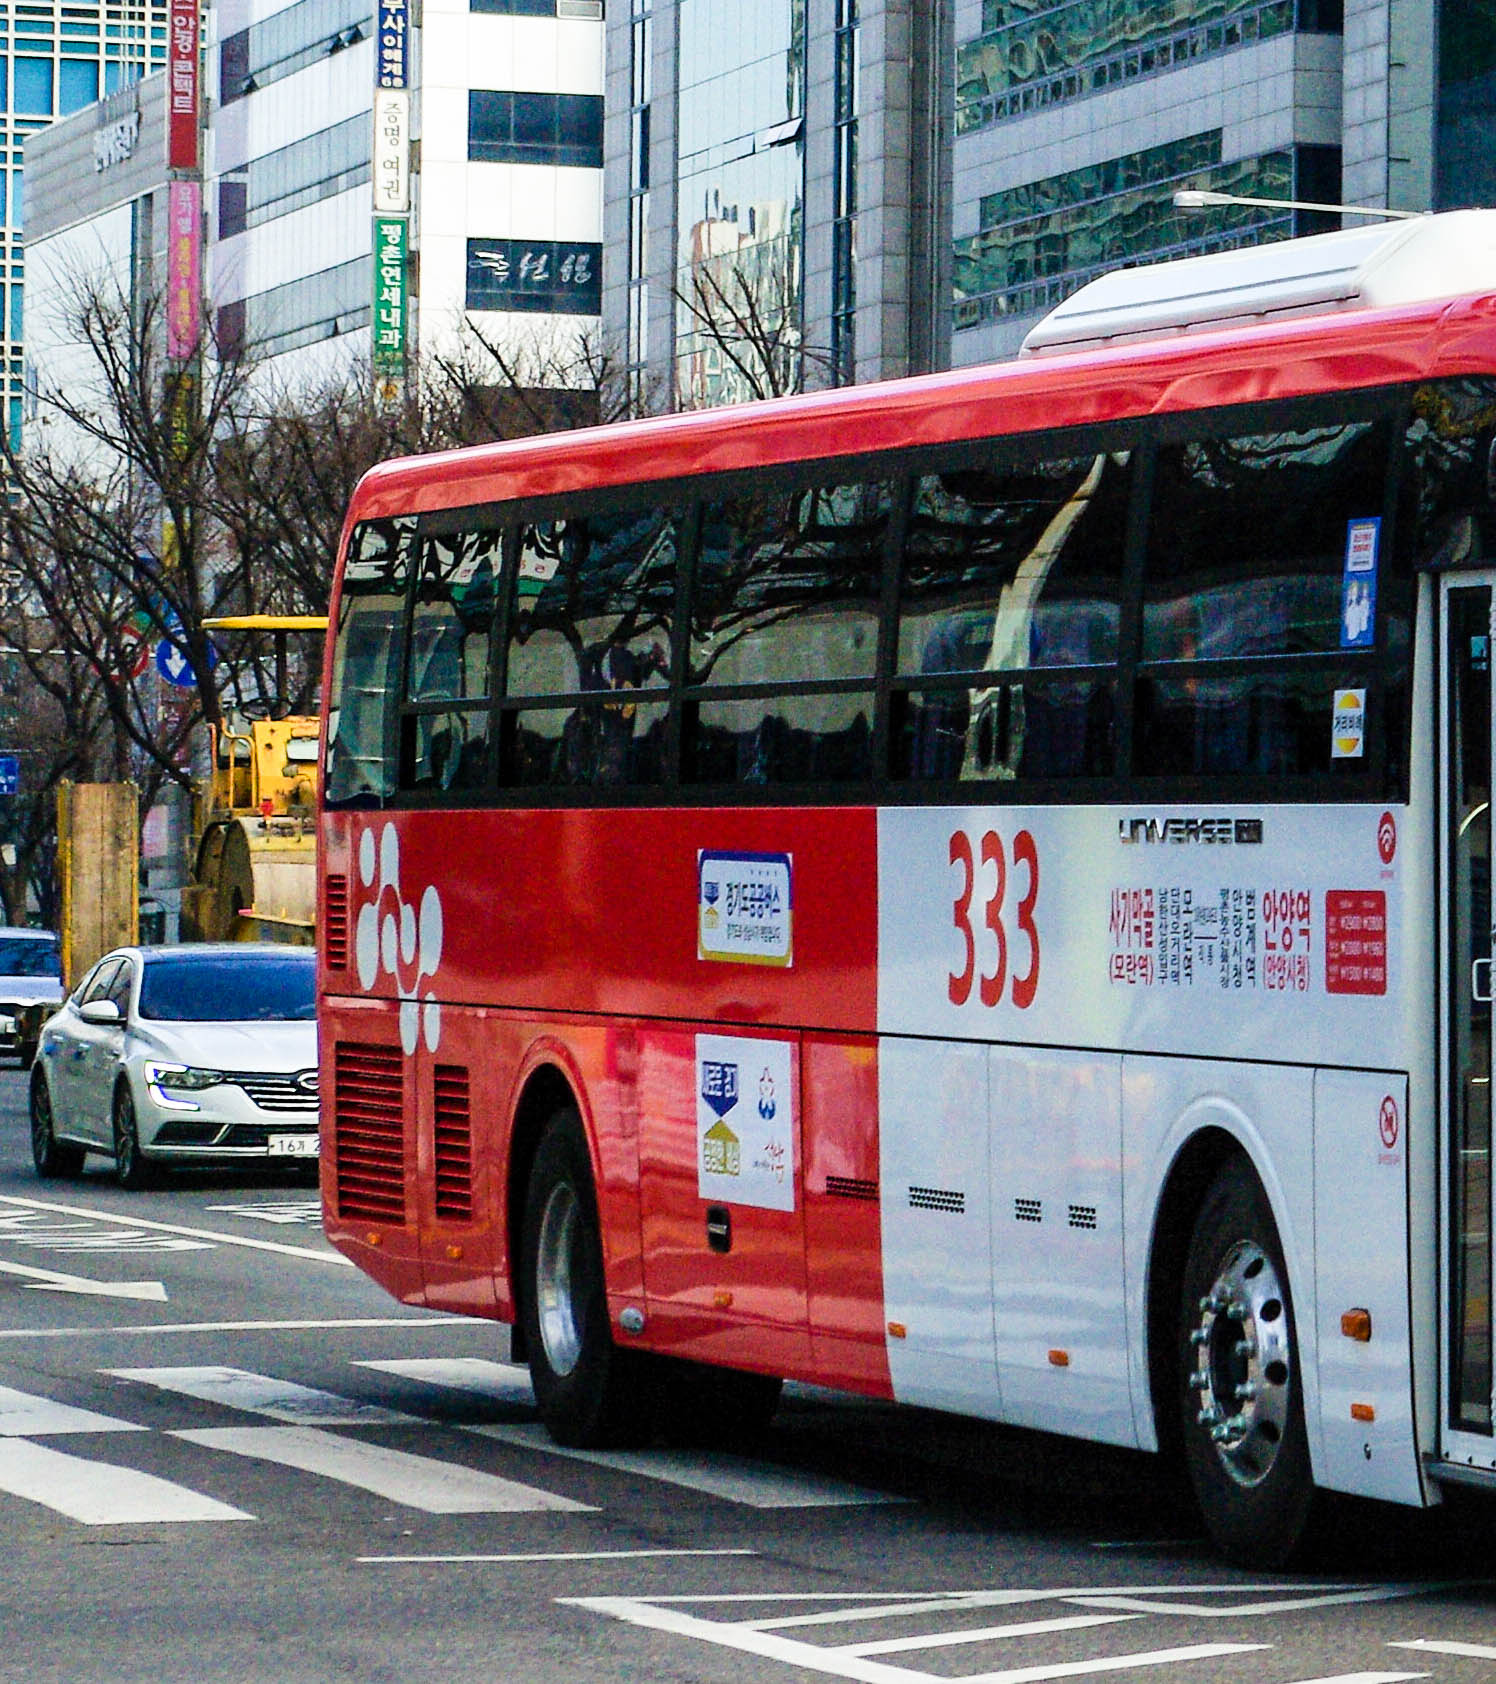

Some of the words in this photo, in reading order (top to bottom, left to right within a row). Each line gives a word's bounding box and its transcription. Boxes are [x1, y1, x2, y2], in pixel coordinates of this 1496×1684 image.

[384, 103, 403, 147] 증명
[383, 156, 401, 200] 여권
[379, 224, 402, 349] 평촌연세내과
[1119, 817, 1233, 844] UNIVERSE
[726, 882, 781, 918] 경기도공공버스
[948, 830, 1040, 1009] 333
[1109, 887, 1155, 948] 사기막골
[1263, 887, 1311, 952] 안양역
[1183, 889, 1193, 985] 모란역
[1109, 953, 1154, 986] (모란역)
